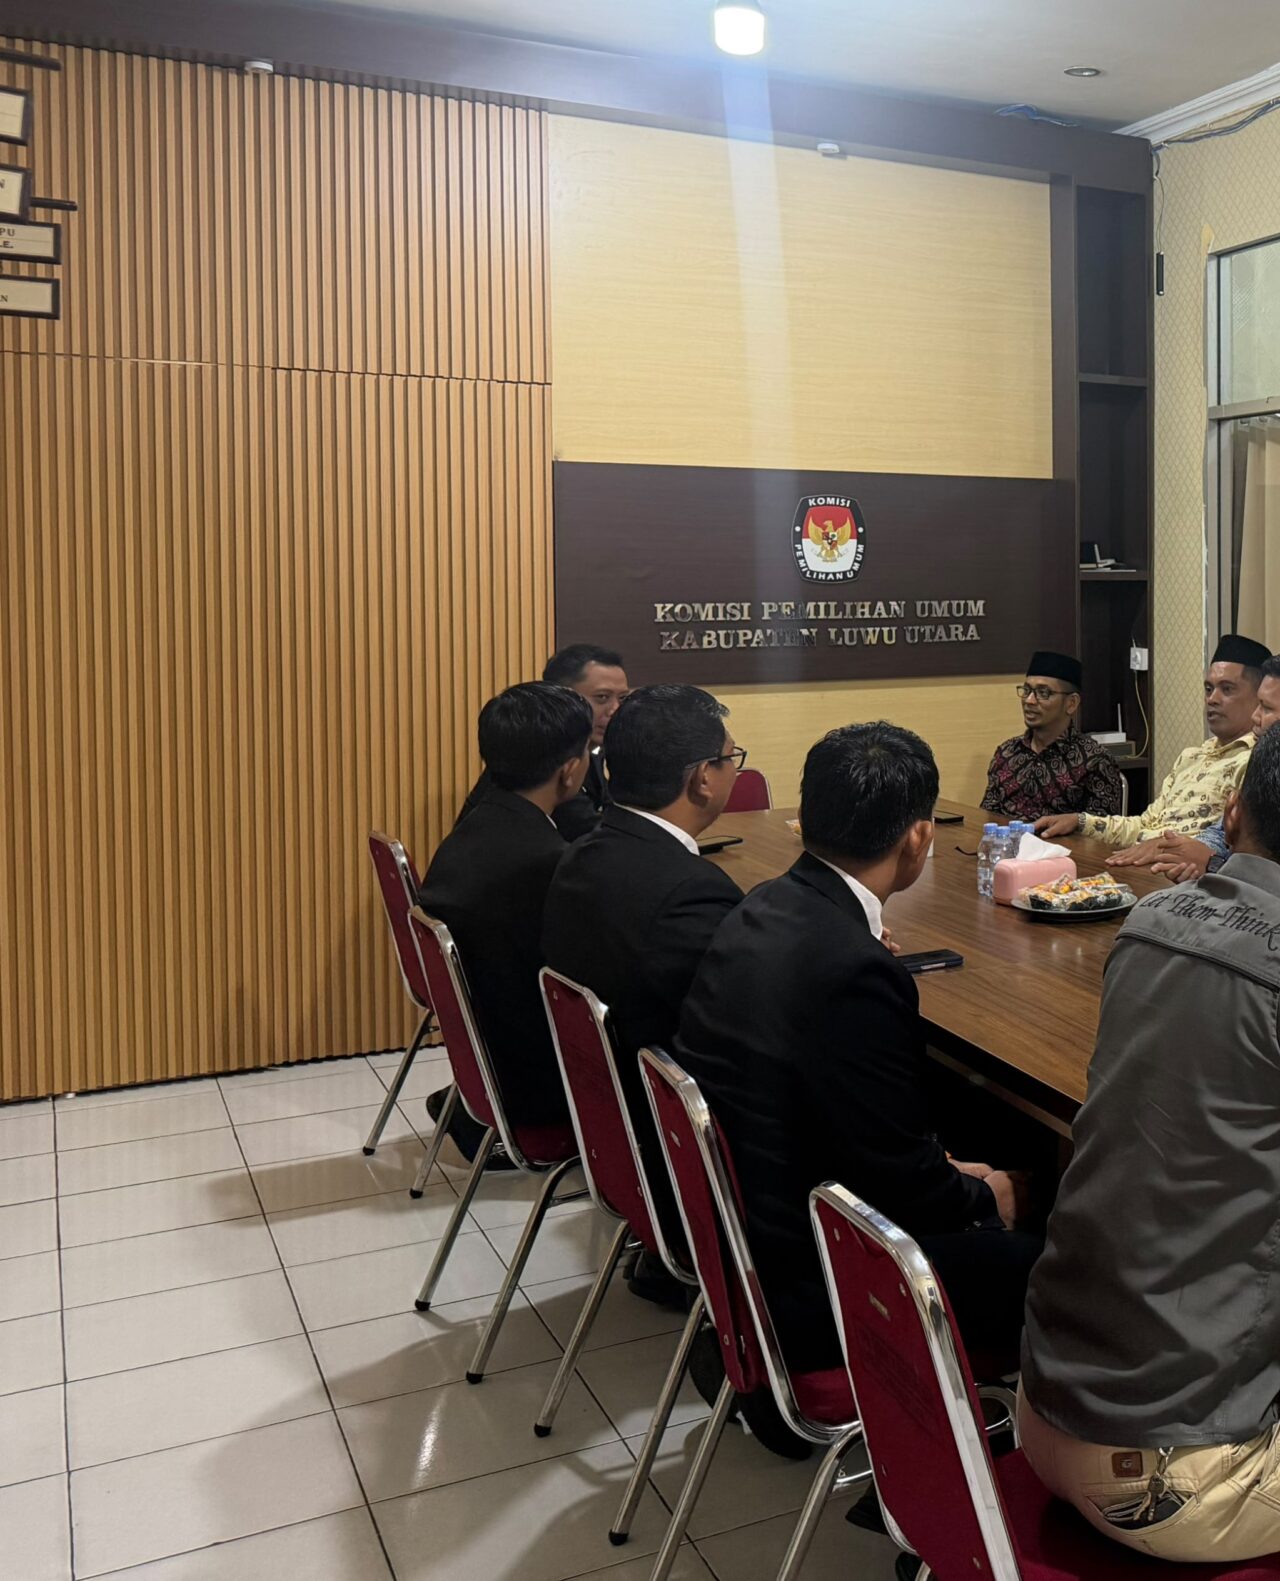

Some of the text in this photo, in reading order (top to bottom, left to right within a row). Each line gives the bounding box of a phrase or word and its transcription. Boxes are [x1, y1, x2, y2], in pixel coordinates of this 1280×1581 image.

[808, 497, 851, 508] KOMISI
[794, 544, 864, 580] PEMILIHAN UMUM
[654, 600, 986, 623] KOMISI PEMILIHAN UMUM
[660, 624, 981, 650] KABUPATEN LUWU UTARA
[1139, 892, 1168, 909] Let
